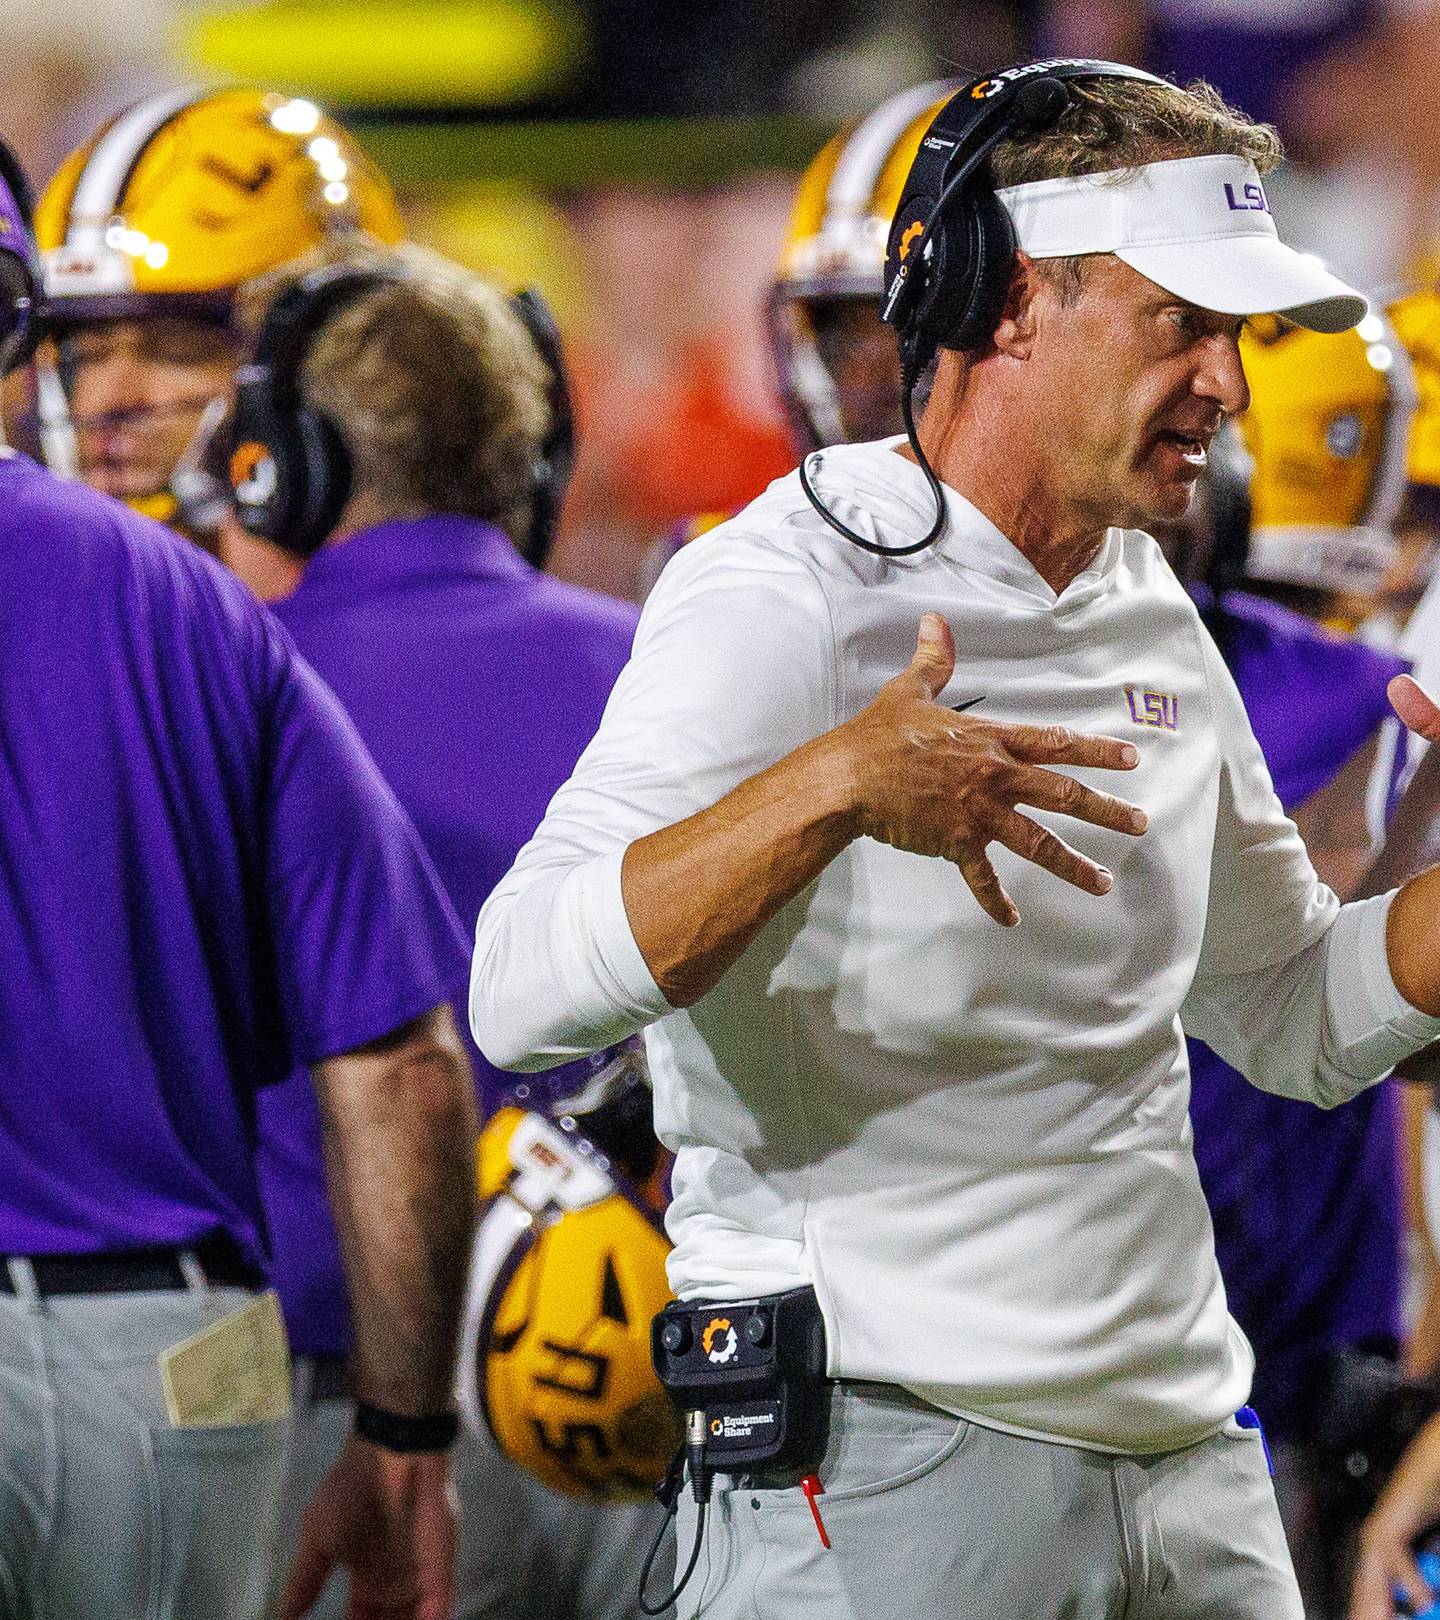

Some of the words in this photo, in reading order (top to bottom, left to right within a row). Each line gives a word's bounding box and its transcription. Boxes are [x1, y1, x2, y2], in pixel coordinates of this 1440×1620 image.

[1122, 684, 1180, 732] LSU
[723, 1413, 774, 1428] Equipment
[724, 1427, 752, 1437] Share
